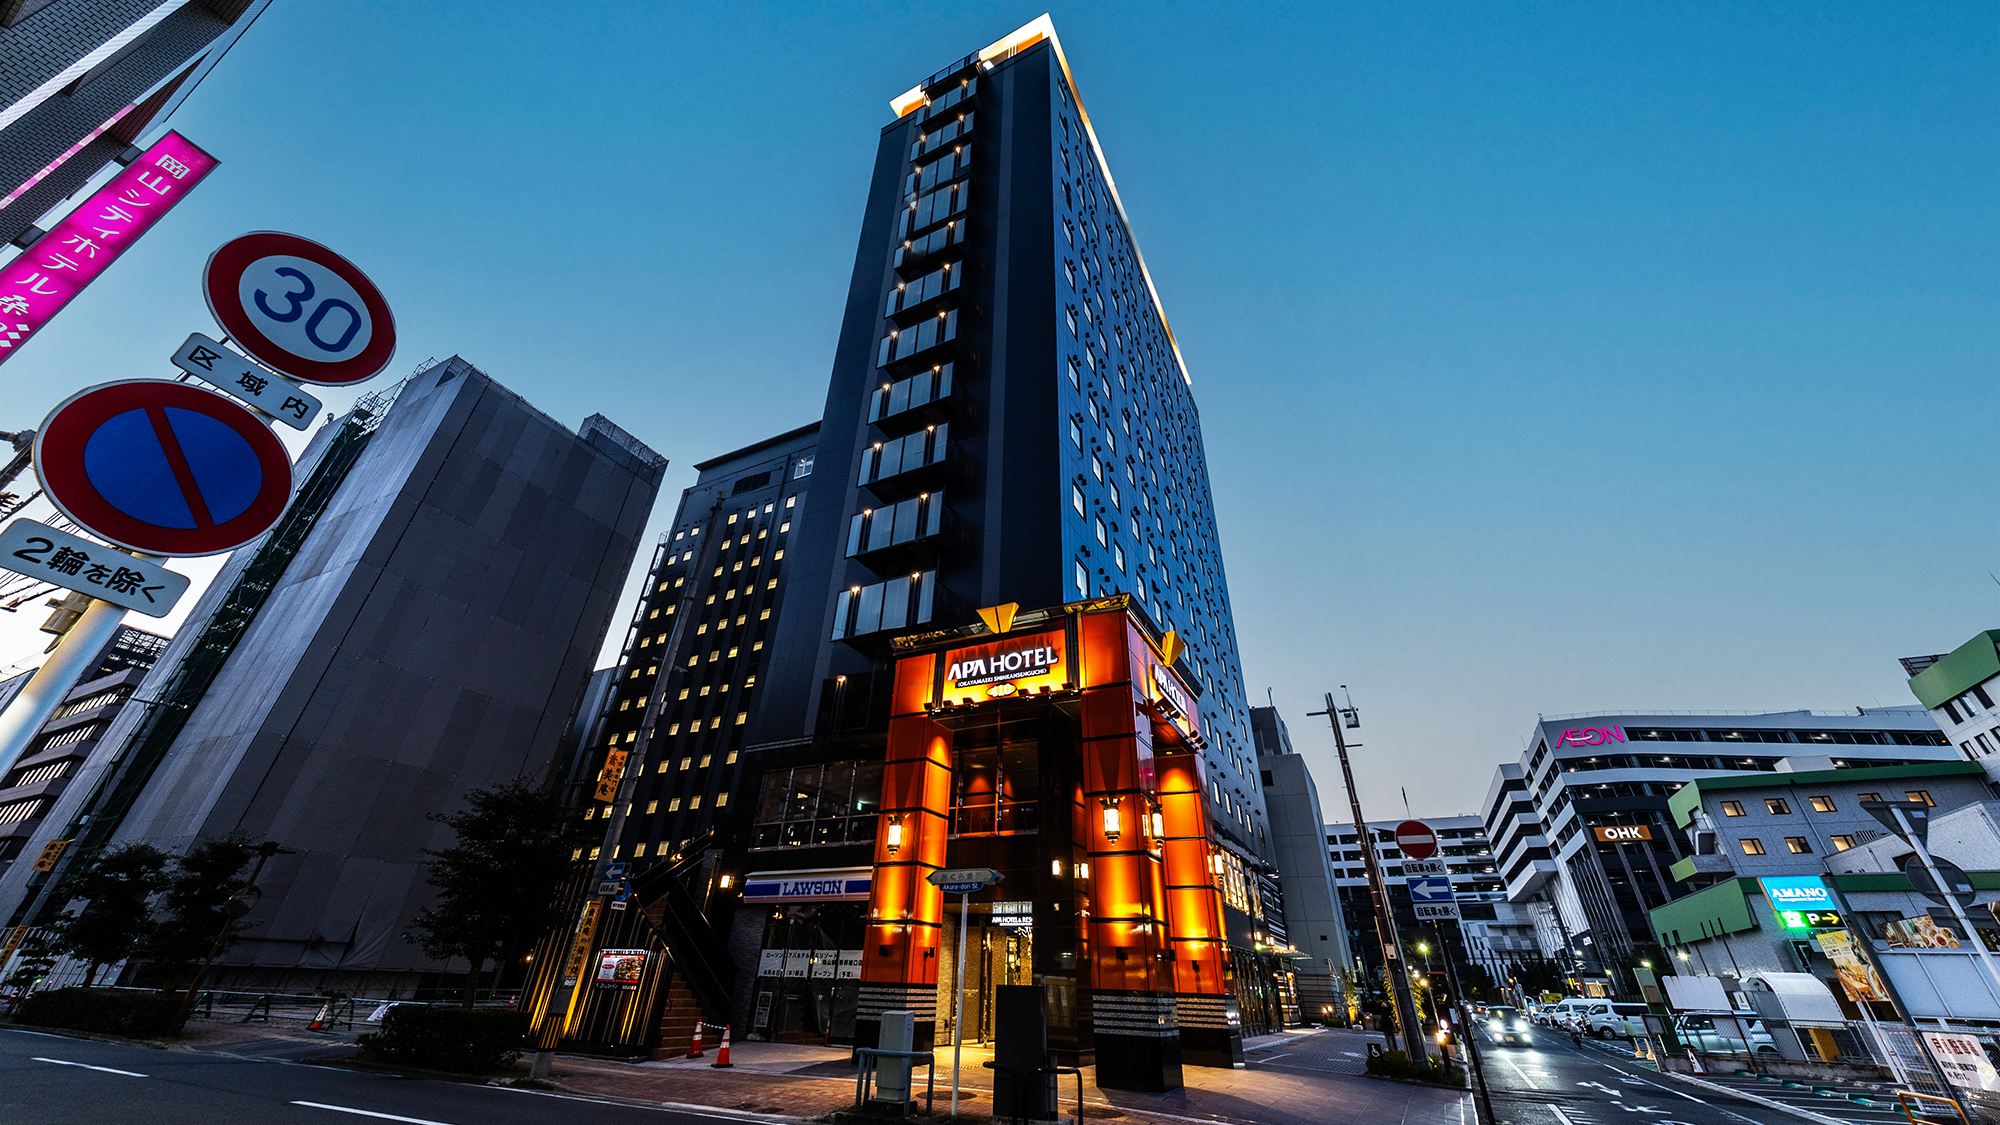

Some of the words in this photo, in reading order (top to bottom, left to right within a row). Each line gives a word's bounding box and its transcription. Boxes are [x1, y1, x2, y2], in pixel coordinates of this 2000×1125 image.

[254, 266, 362, 353] 30
[188, 344, 309, 420] 区域内
[13, 536, 165, 604] 2輪を除く
[948, 659, 987, 681] APA
[990, 646, 1058, 674] HOTEL
[1604, 826, 1643, 840] OHK
[1405, 862, 1443, 873] 自転車を除く
[782, 880, 842, 896] LAWSON
[1772, 887, 1828, 898] AMANO
[1416, 905, 1456, 917] 自転車を除く
[1806, 913, 1820, 925] P
